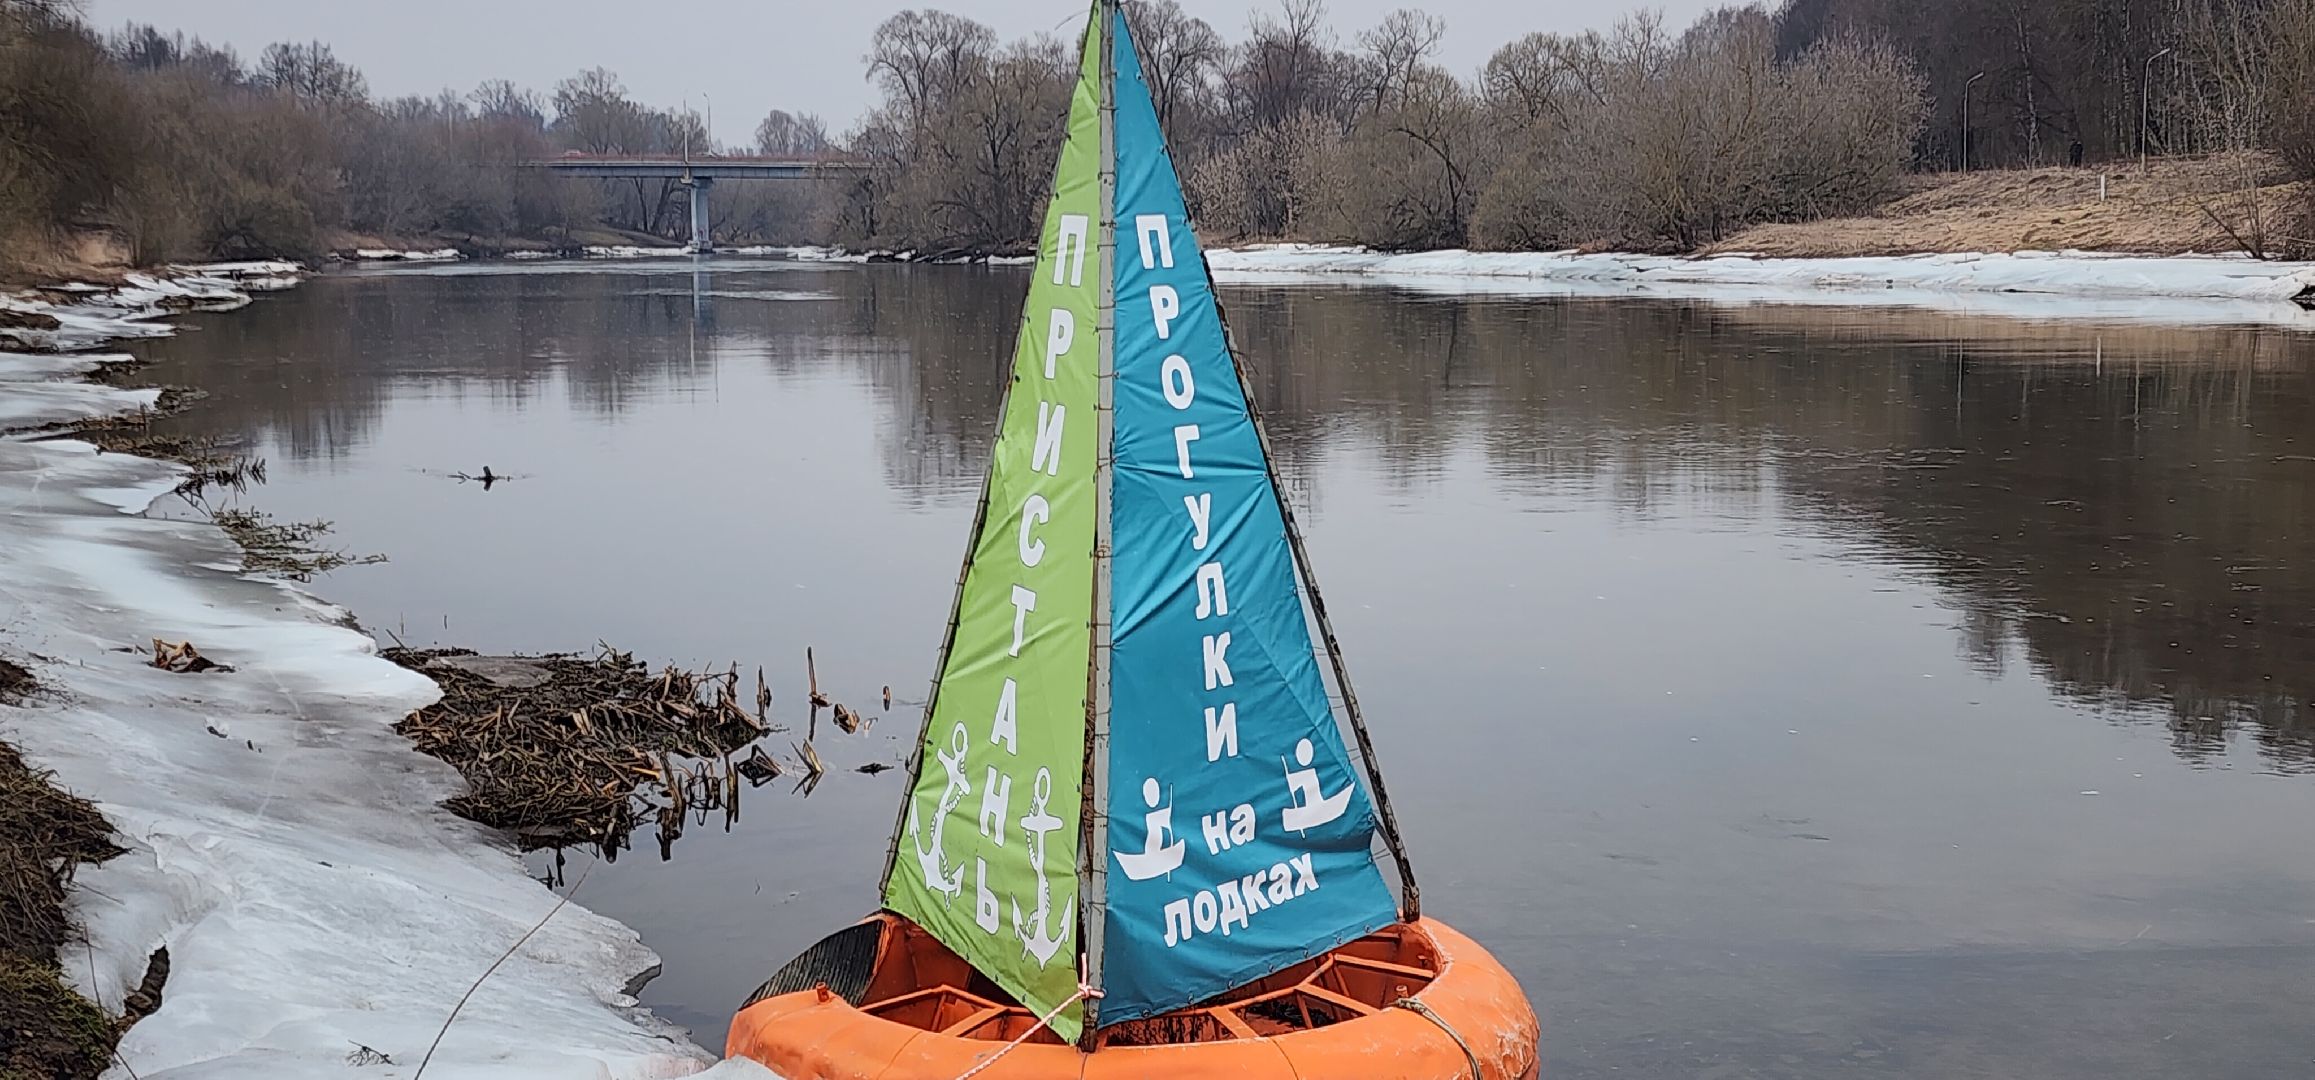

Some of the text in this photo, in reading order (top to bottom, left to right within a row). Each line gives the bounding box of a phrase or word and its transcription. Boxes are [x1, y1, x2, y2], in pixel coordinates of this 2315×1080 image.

[975, 214, 1089, 934] ПРИСТАНЬ
[1135, 214, 1238, 762] ПРОГУЛКИ
[1164, 852, 1319, 948] лодках
[1201, 803, 1256, 855] на
